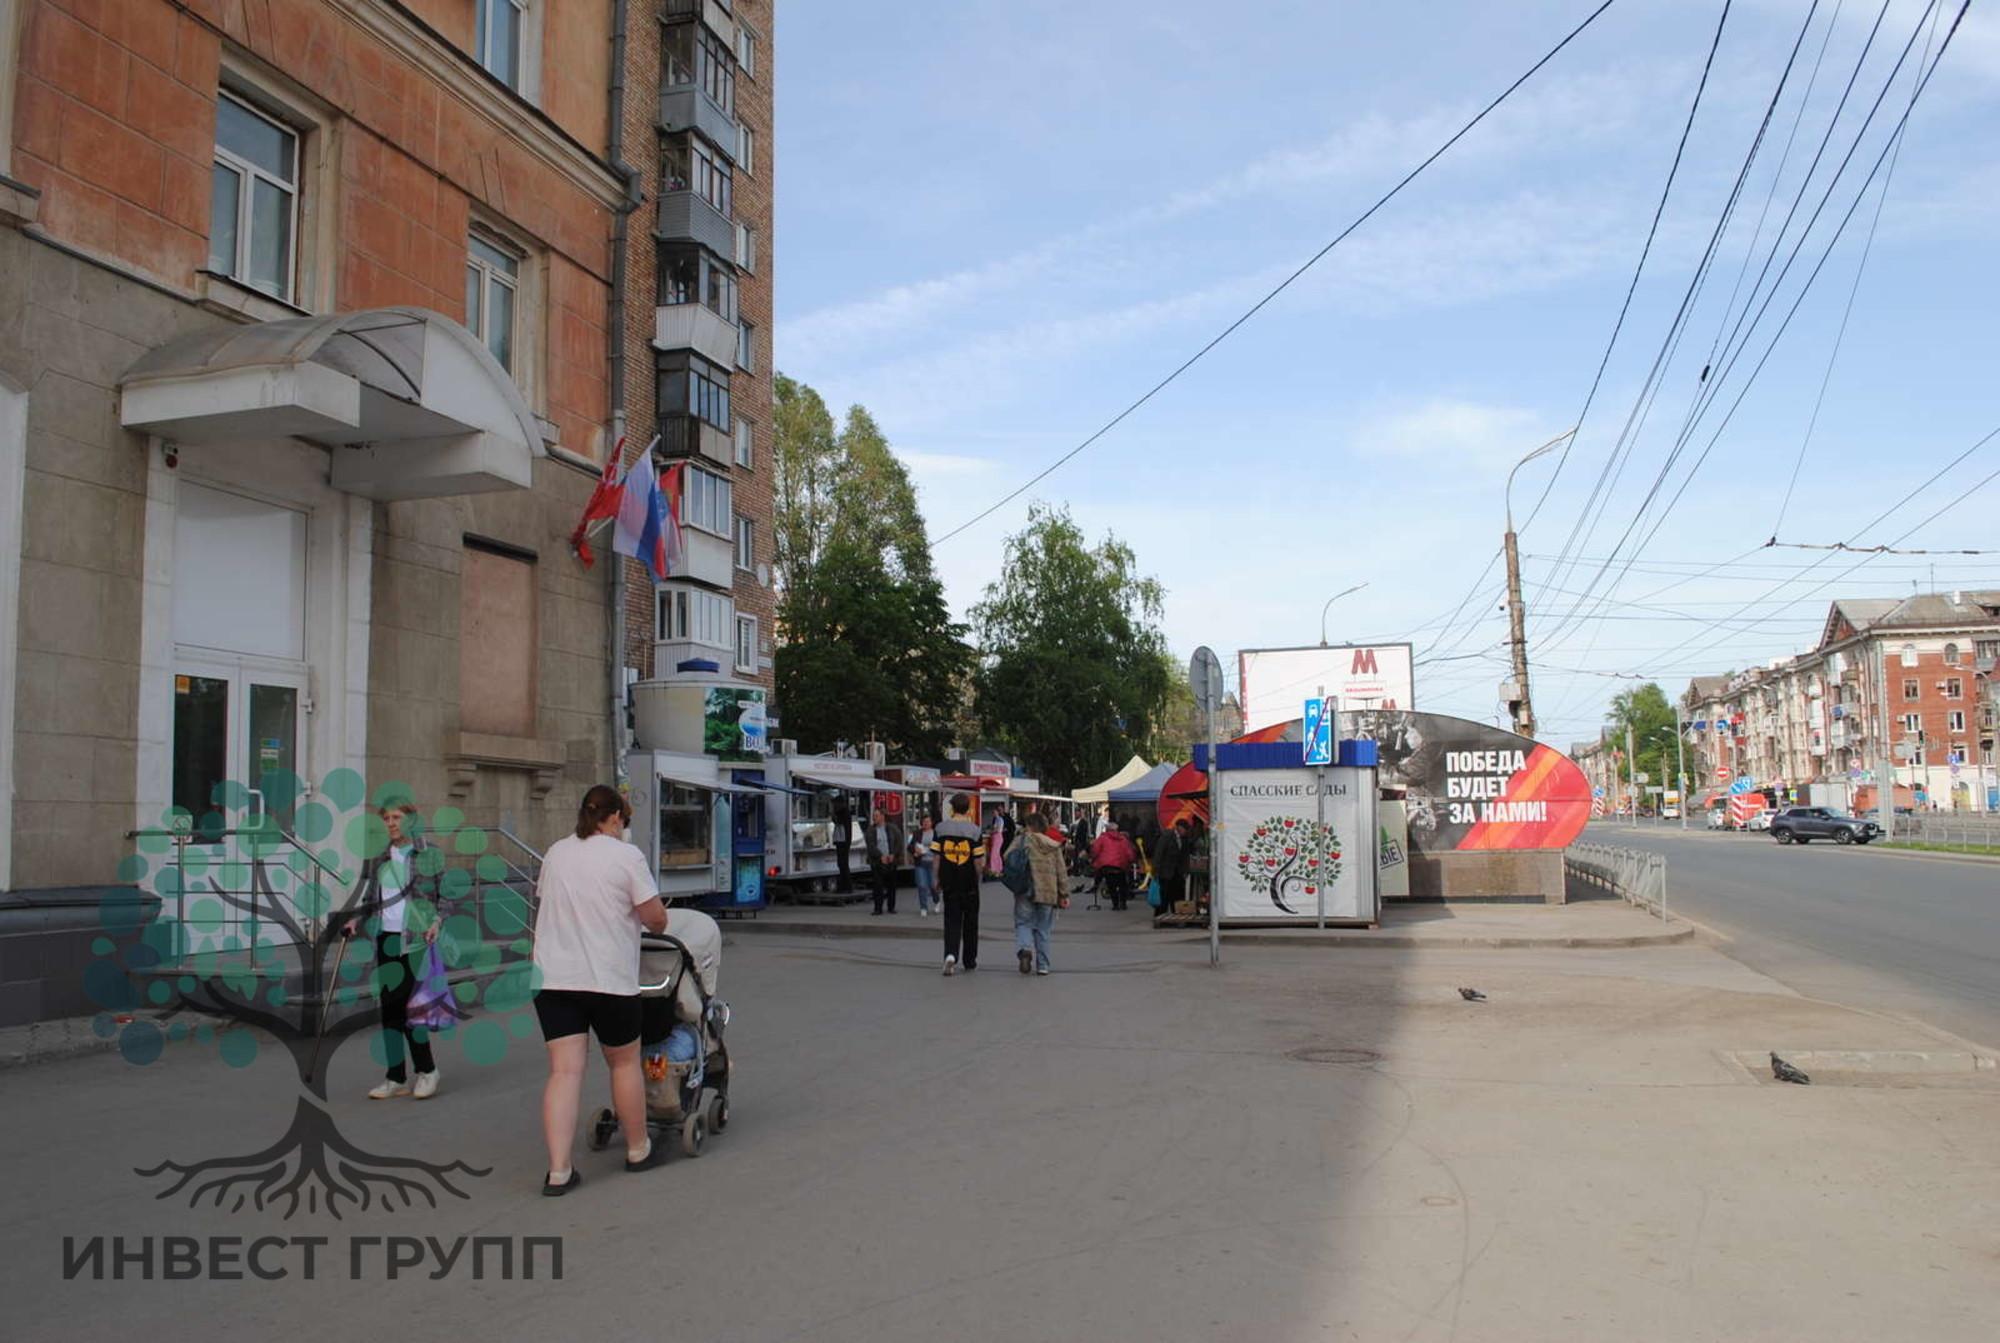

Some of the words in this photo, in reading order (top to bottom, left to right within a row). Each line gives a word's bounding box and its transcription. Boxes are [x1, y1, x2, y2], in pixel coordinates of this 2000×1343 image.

[1352, 649, 1378, 674] М
[1446, 750, 1527, 774] ПОБЕДА
[1230, 784, 1303, 797] СПАССКИЕ
[1306, 784, 1347, 797] СДЫ
[1447, 776, 1509, 800] БУДЕТ
[1449, 802, 1476, 824] ЗА
[1481, 801, 1547, 823] НАМИ!
